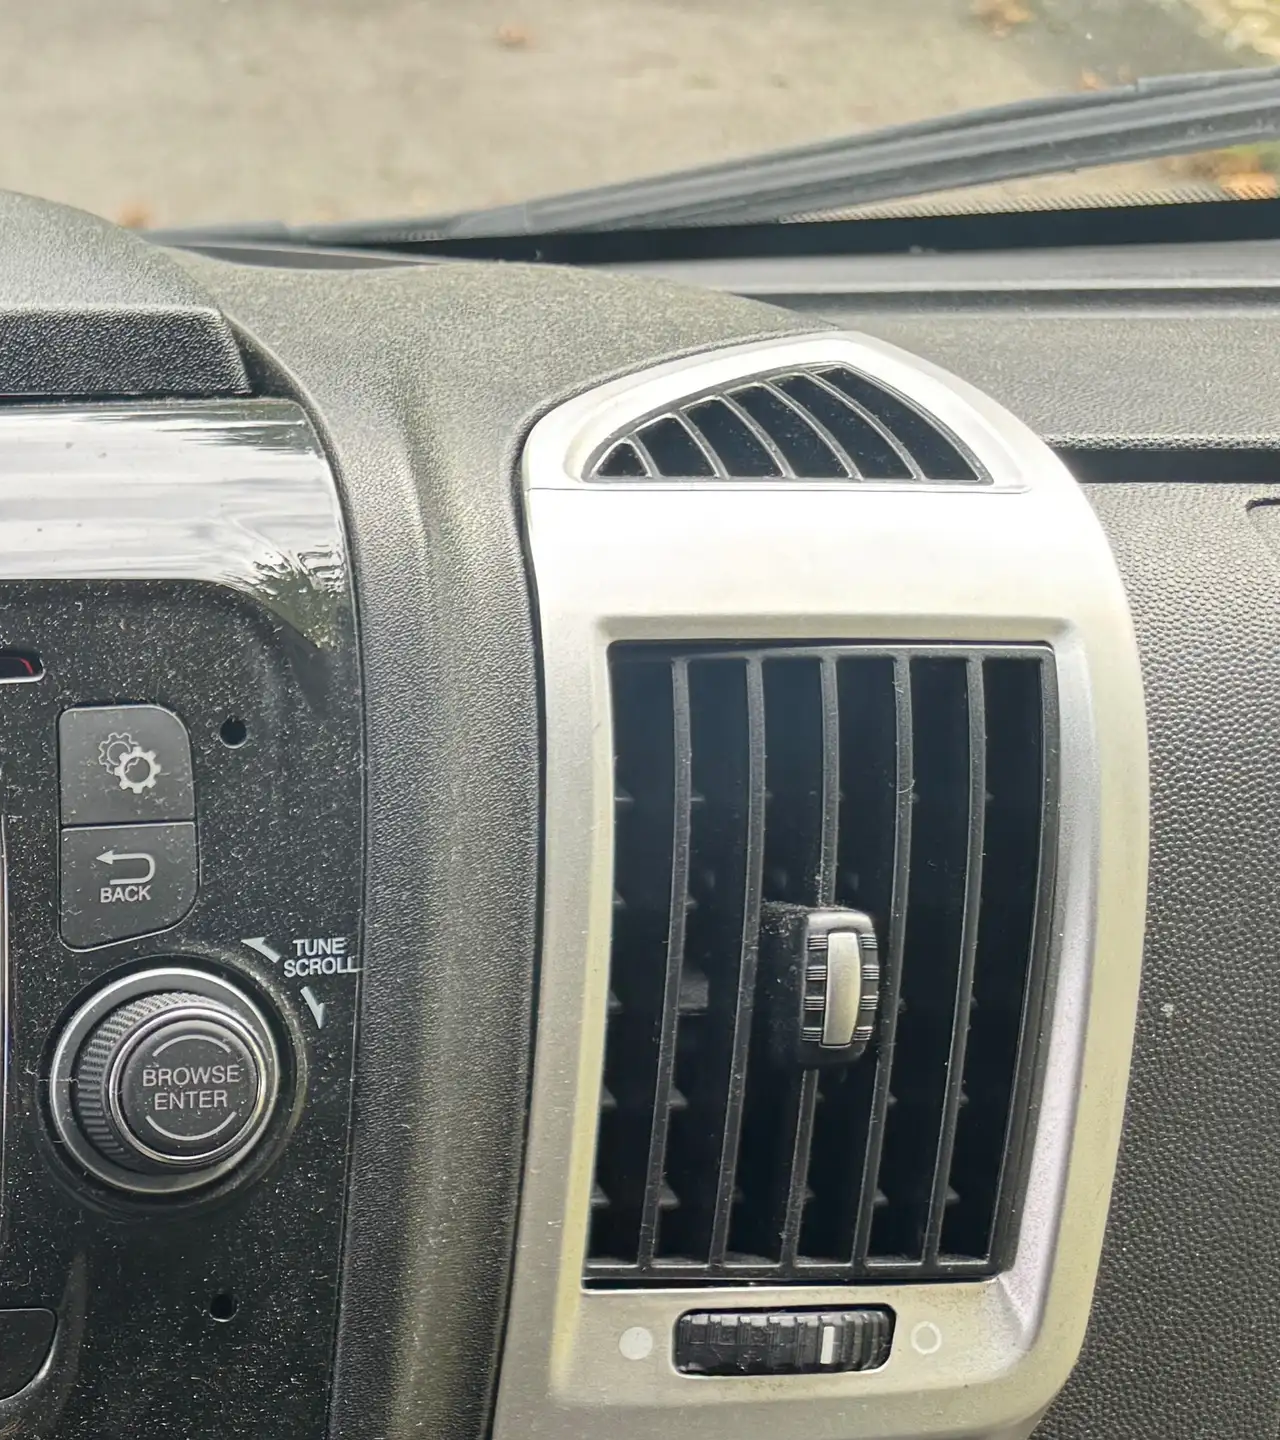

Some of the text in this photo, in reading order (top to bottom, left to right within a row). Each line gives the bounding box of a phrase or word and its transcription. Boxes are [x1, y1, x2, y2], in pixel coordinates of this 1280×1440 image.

[99, 886, 152, 904] BACK
[292, 937, 347, 956] TUNE
[283, 956, 357, 977] SCROLL
[142, 1065, 240, 1087] BROWSE
[154, 1091, 228, 1112] ENTER
